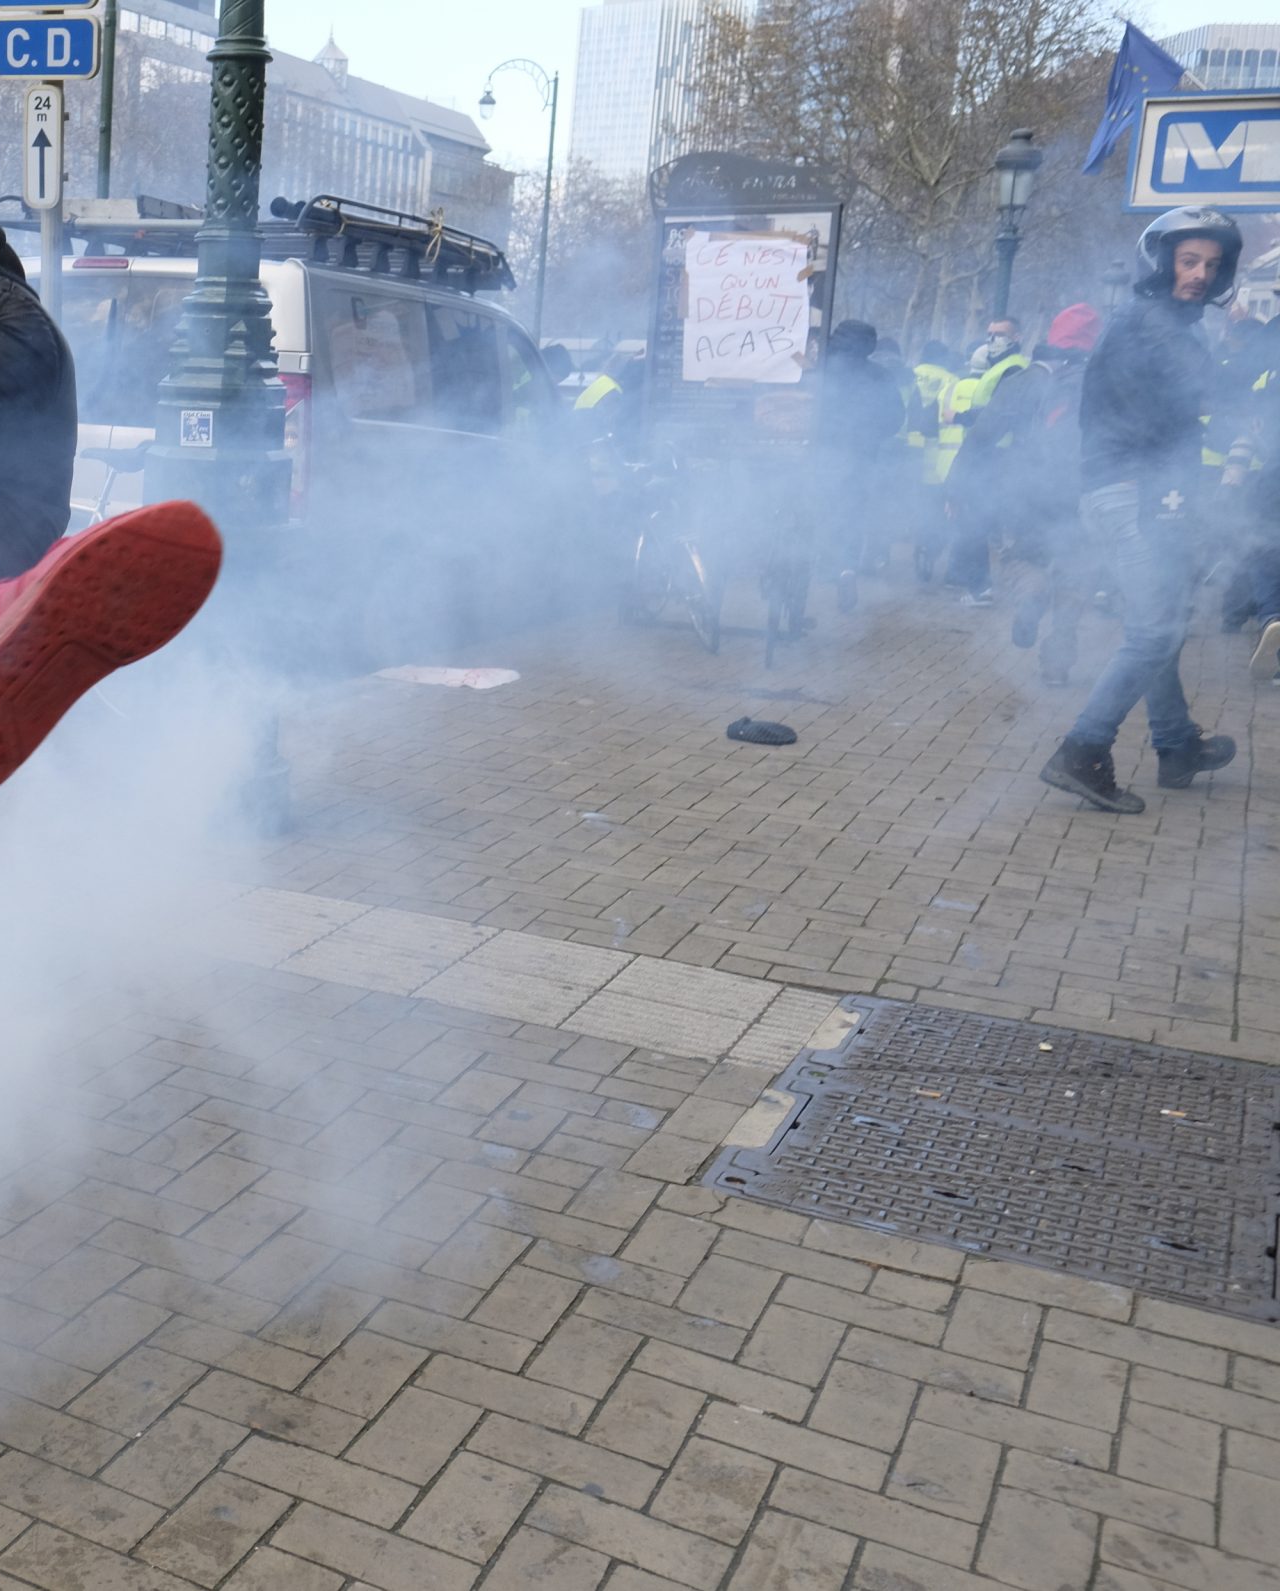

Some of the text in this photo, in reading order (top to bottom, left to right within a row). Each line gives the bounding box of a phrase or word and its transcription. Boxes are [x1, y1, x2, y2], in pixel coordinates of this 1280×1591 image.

[6, 27, 80, 68] C.D.
[34, 96, 52, 110] 24
[36, 112, 48, 122] m
[697, 242, 734, 266] CE
[743, 245, 808, 267] N'EST
[695, 325, 795, 362] ACAB
